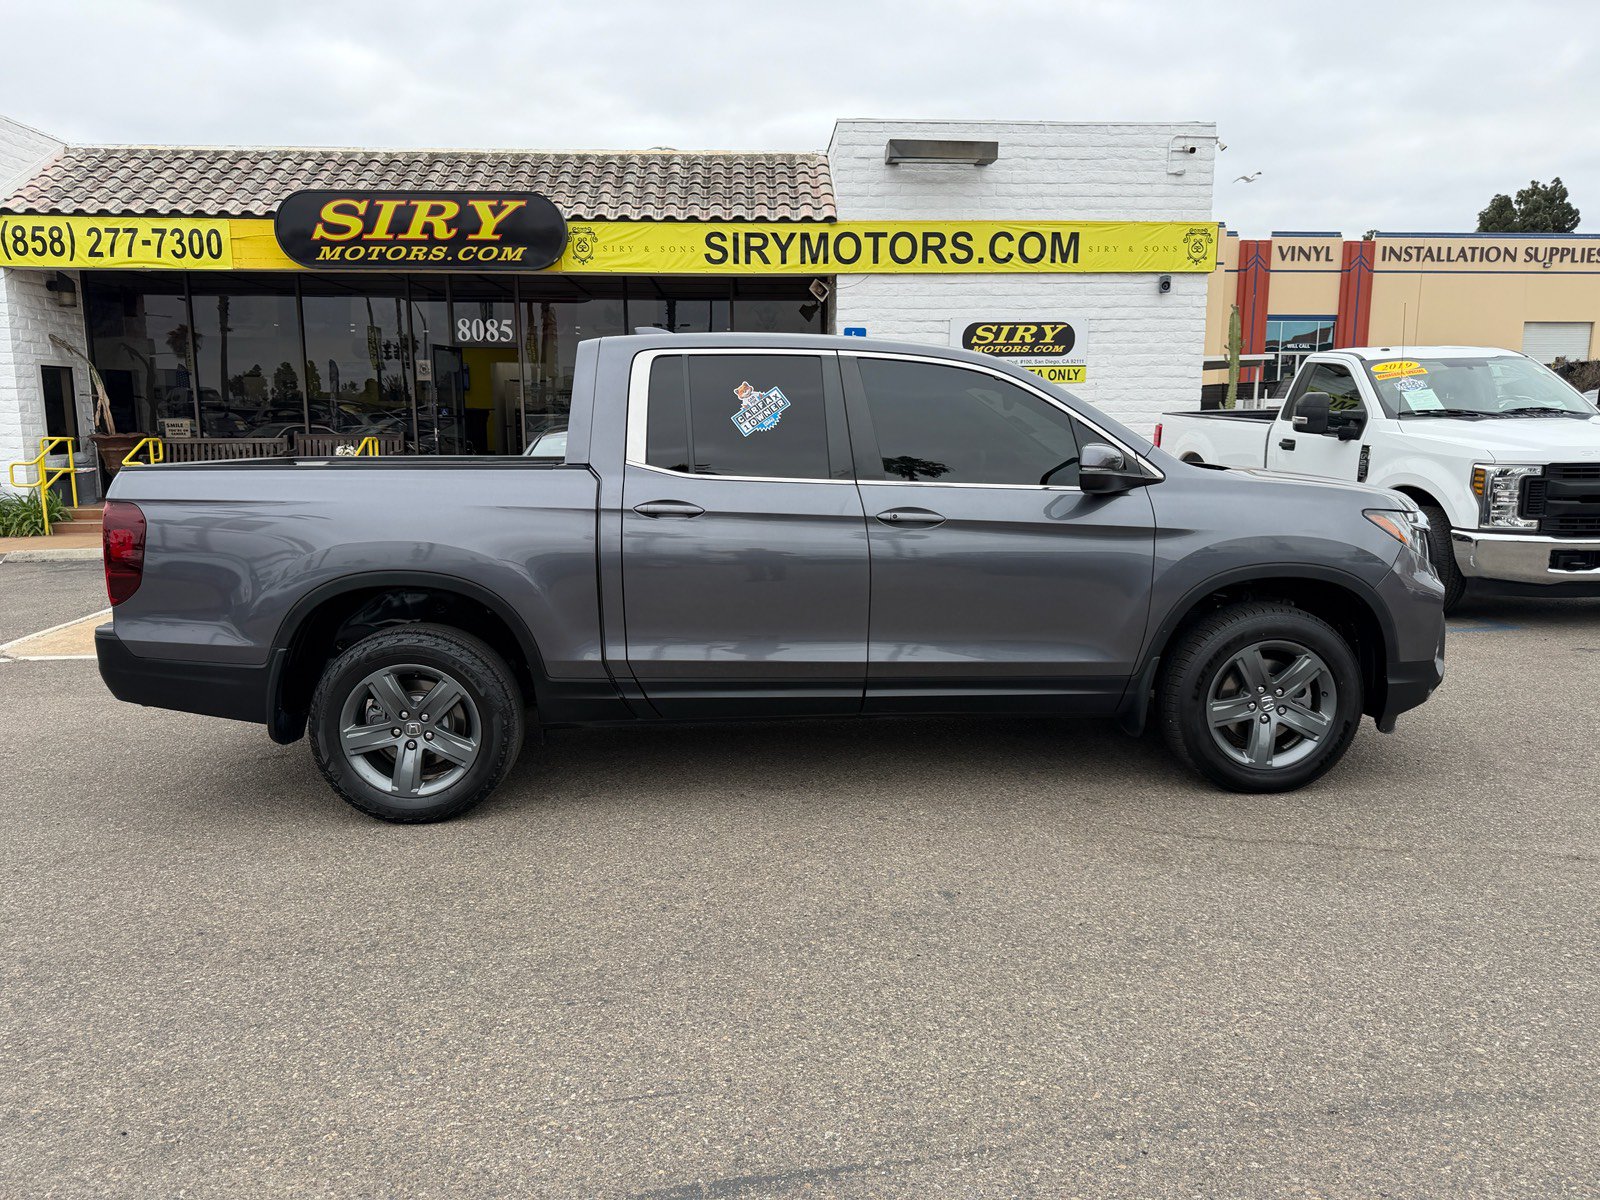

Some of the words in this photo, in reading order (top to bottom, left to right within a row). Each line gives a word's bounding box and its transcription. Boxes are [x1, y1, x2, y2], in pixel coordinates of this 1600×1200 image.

[311, 198, 527, 241] SIRY
[1, 220, 76, 261] (858)
[86, 227, 223, 260] 277-7300
[602, 245, 634, 253] SIRY
[644, 245, 650, 253] &
[660, 245, 695, 253] SONS
[703, 231, 1080, 265] SIRYMOTORS.COM
[315, 246, 528, 262] MOTORS.COM
[1278, 245, 1334, 262] VINYL
[1381, 245, 1518, 263] INSTALLATION
[457, 318, 514, 342] 8085
[971, 324, 1068, 344] SIRY
[972, 345, 1066, 353] MOTORS.COM
[1048, 369, 1081, 381] ONLY
[1381, 361, 1413, 371] 2019
[738, 393, 780, 423] CARFAX
